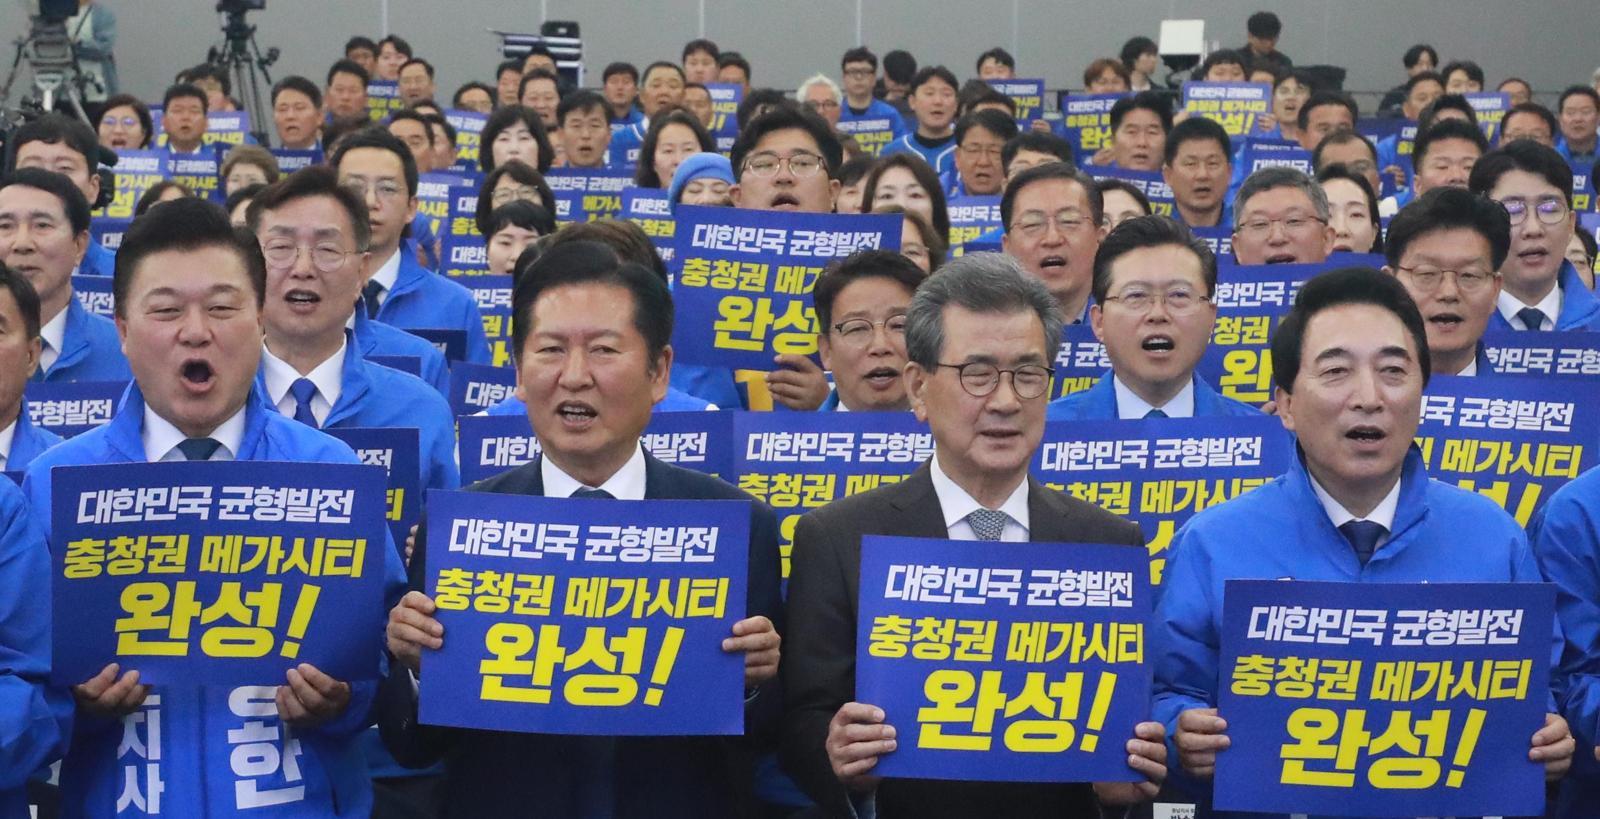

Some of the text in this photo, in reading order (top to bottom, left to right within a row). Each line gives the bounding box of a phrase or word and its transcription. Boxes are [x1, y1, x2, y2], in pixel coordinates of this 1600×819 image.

[544, 176, 587, 191] 한민국
[630, 198, 671, 215] 대한민
[947, 206, 989, 222] 한민국
[692, 223, 787, 255] 대한민국
[681, 257, 769, 293] 충청권
[76, 291, 115, 315] 발전
[474, 289, 513, 309] 민국
[1212, 281, 1285, 308] 한민국
[714, 295, 821, 356] 완성
[1209, 316, 1271, 346] 청권
[1485, 347, 1600, 375] 한민국 균형
[464, 381, 517, 407] 대한
[28, 399, 113, 426] 균형발전
[1459, 397, 1575, 432] 균형발전
[480, 432, 708, 468] 대한 발전
[746, 432, 937, 463] 대한민국 균형발
[1041, 436, 1262, 471] 대한민국 균형발전
[1440, 438, 1584, 479] 메가시티
[77, 486, 354, 524] 대한민국 균형발전
[738, 472, 836, 508] 충청권
[63, 534, 366, 579] 충청권 메가시티
[448, 518, 719, 563] 대한민국 균형발전
[434, 568, 730, 619] 충청권 메가시티
[884, 564, 1133, 607] 대한민국 균형발전
[114, 580, 321, 659] 완성!
[1247, 606, 1524, 646] 대한민국 균형발전
[868, 615, 1144, 664] 충청권 메가시티
[479, 622, 685, 707] 완성!
[1230, 654, 1533, 702] 충청권 메가시티
[916, 669, 1118, 753] 완성!
[117, 694, 165, 814] 지사
[1279, 707, 1488, 790] 완성!
